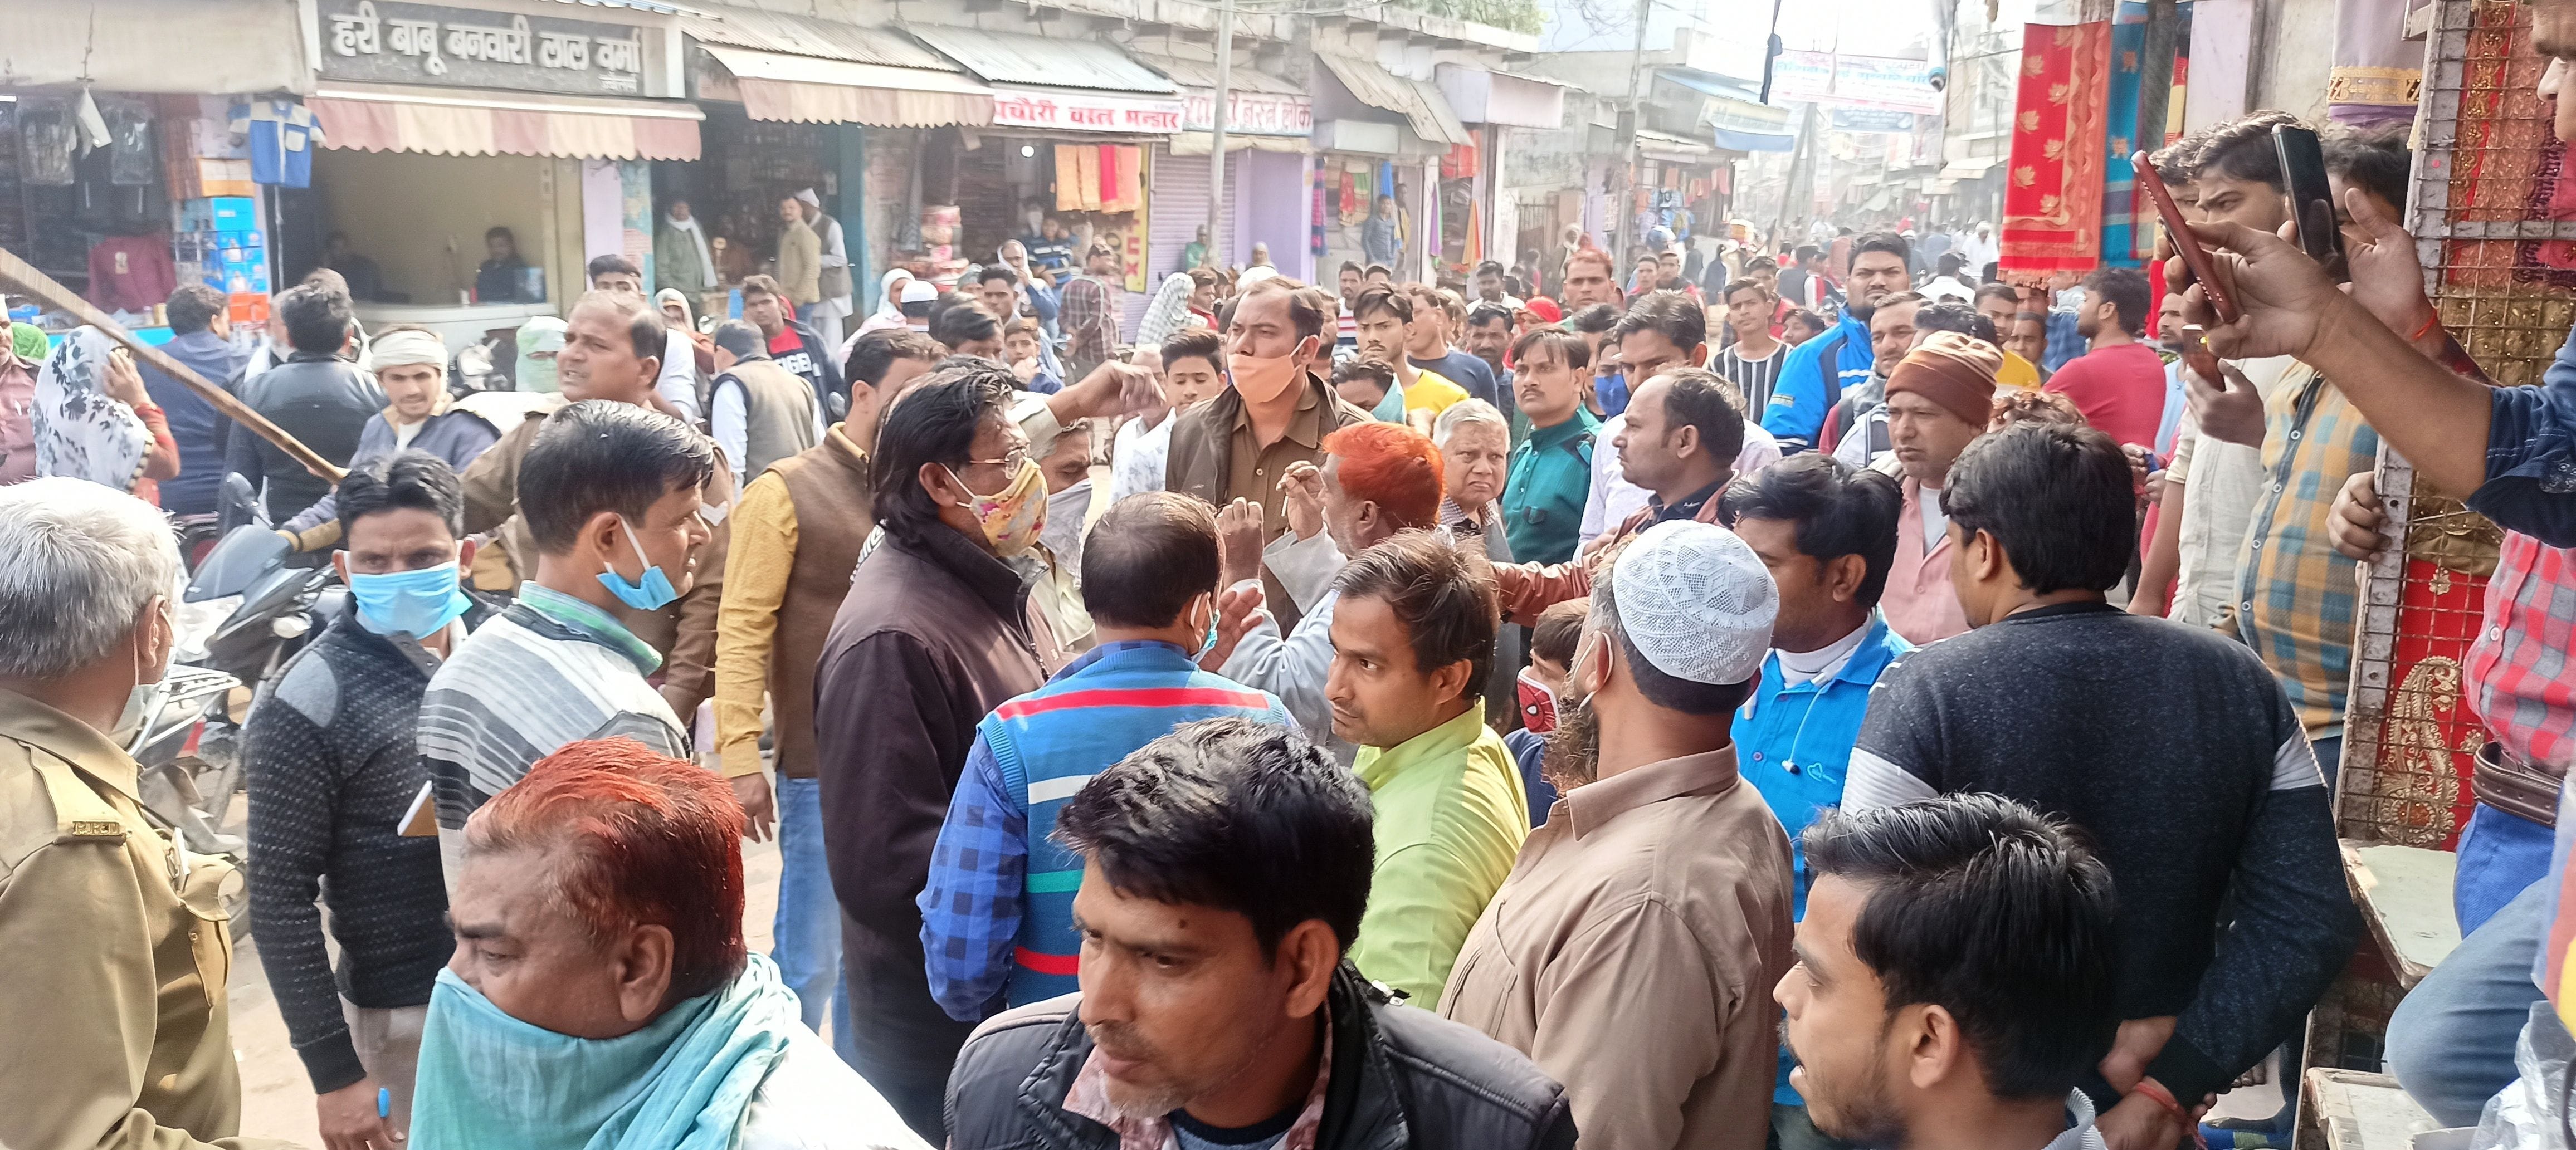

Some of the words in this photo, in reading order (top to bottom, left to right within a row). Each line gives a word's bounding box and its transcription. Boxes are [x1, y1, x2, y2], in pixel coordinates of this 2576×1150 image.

[329, 1, 380, 57] हरी
[387, 18, 448, 76] बाबू
[444, 15, 533, 65] बनवारी
[538, 31, 591, 71] लाल
[594, 28, 640, 74] वर्मा
